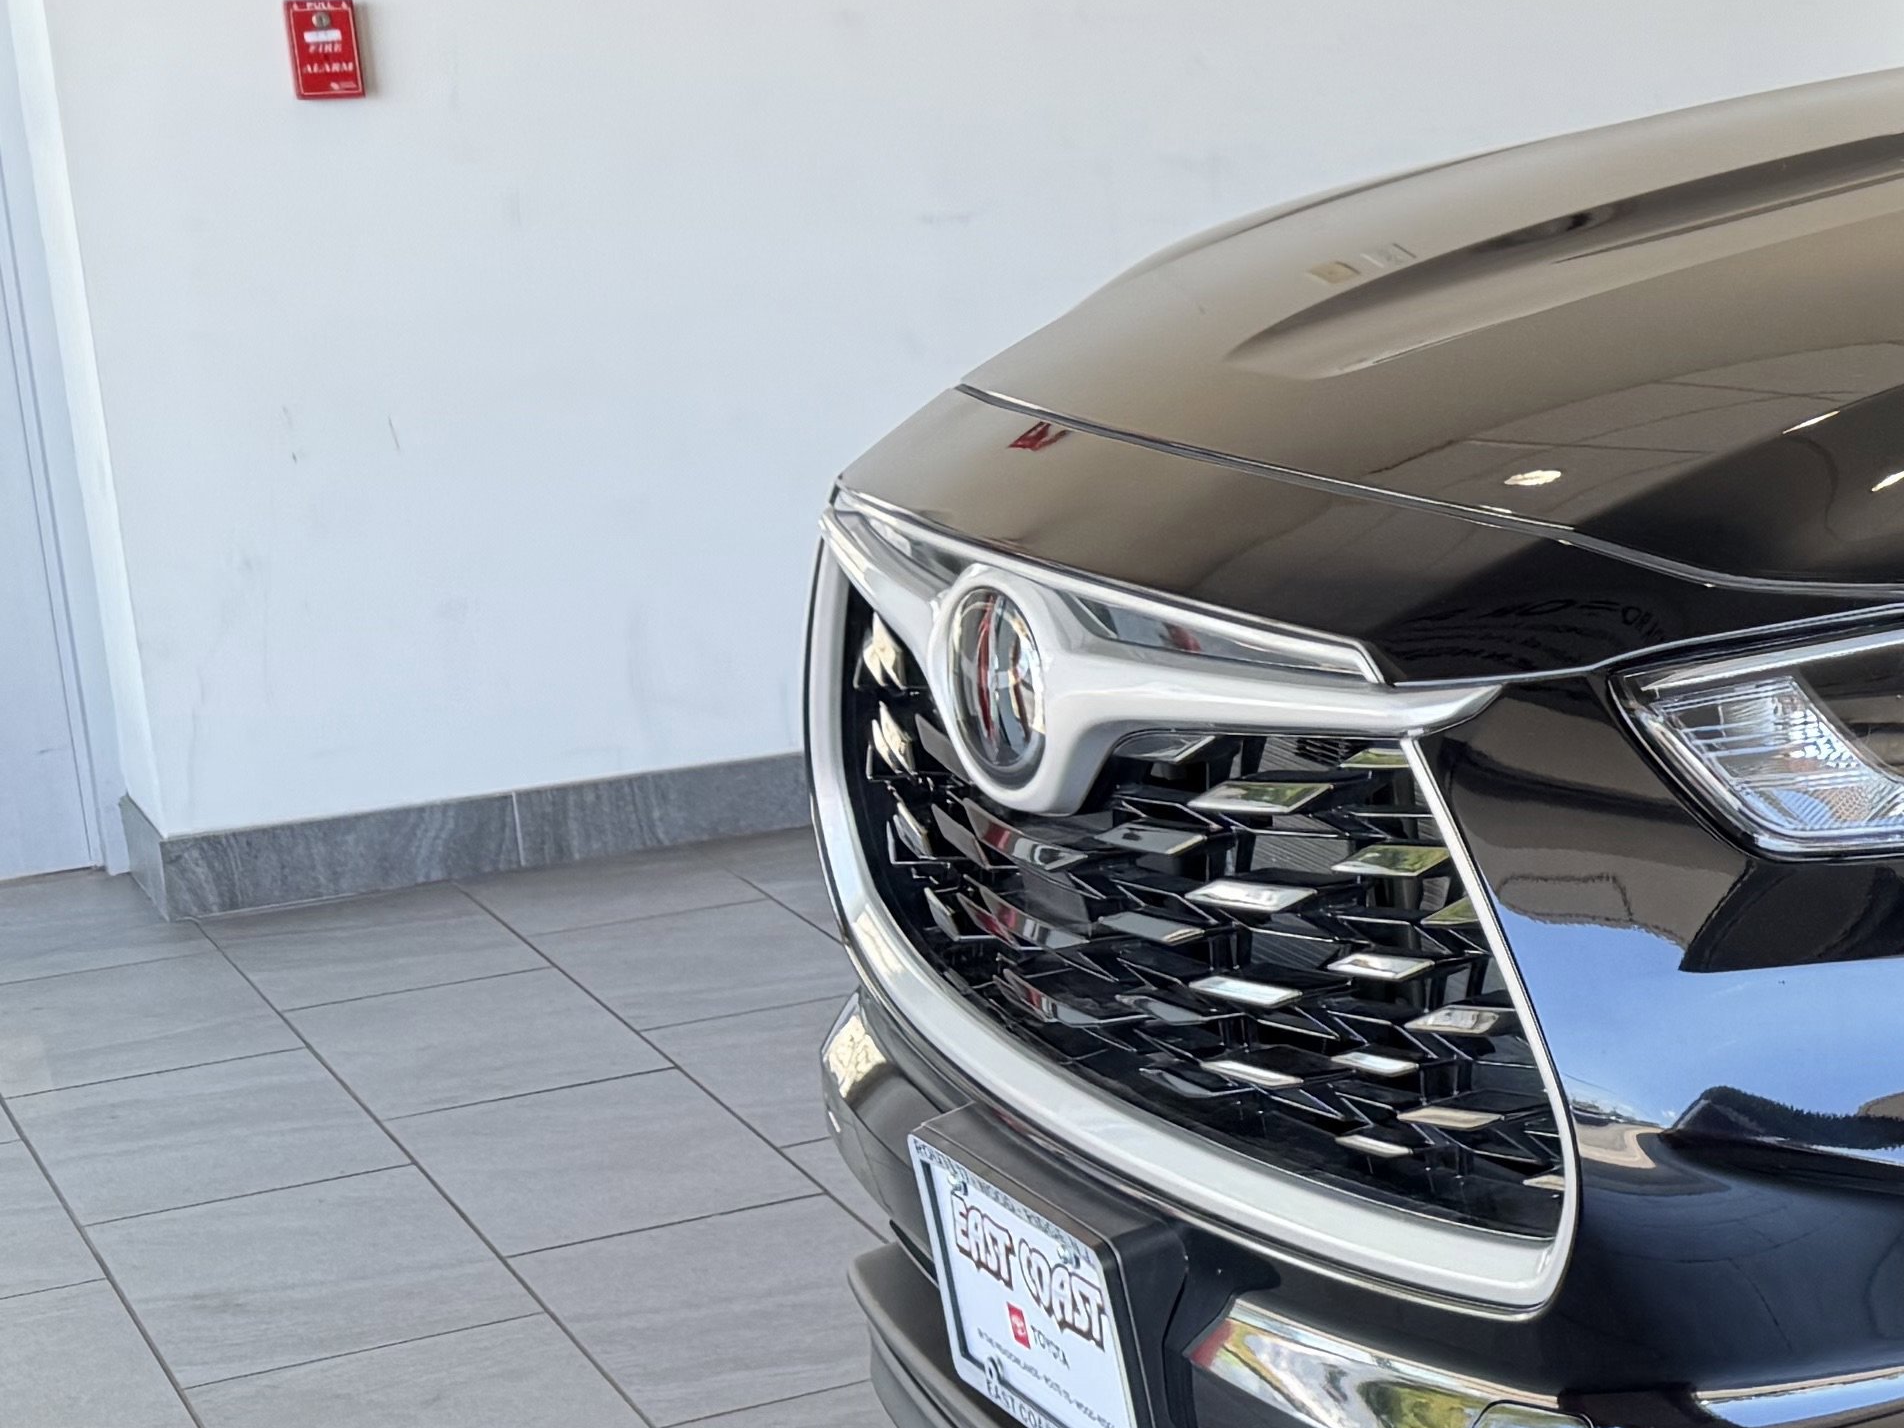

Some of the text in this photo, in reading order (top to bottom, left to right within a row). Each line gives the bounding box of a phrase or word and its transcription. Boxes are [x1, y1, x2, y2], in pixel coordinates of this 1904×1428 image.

[302, 61, 353, 74] ALARM
[951, 1191, 1107, 1352] EAST COAST
[1030, 1324, 1071, 1371] TOYOTA
[987, 1378, 1016, 1416] EAST
